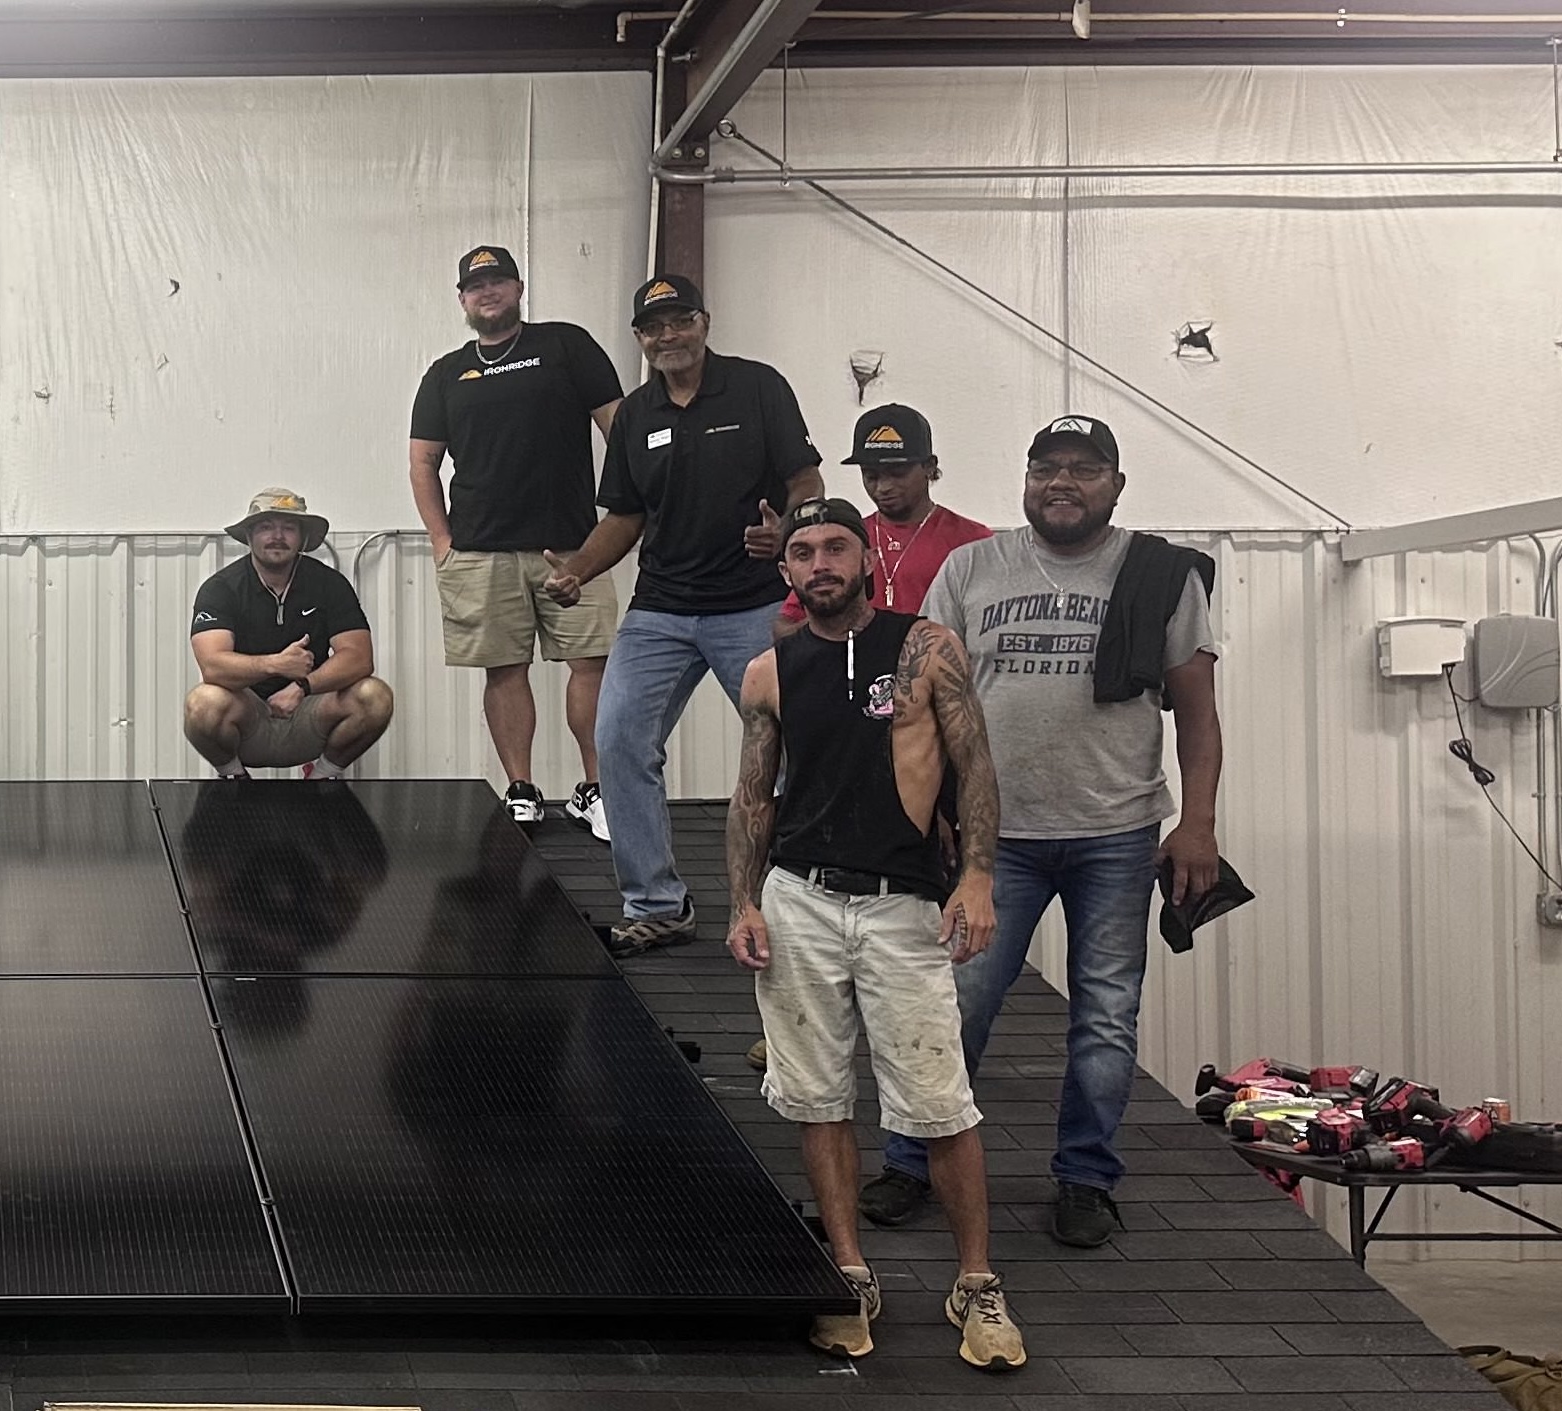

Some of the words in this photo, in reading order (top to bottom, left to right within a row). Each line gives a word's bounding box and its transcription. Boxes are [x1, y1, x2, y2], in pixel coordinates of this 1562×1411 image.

[484, 357, 541, 376] IRONRIDGE
[979, 592, 1059, 636] DAYTONA
[1064, 592, 1110, 626] BEAC
[1001, 635, 1042, 652] EST.
[1051, 635, 1091, 652] 1876
